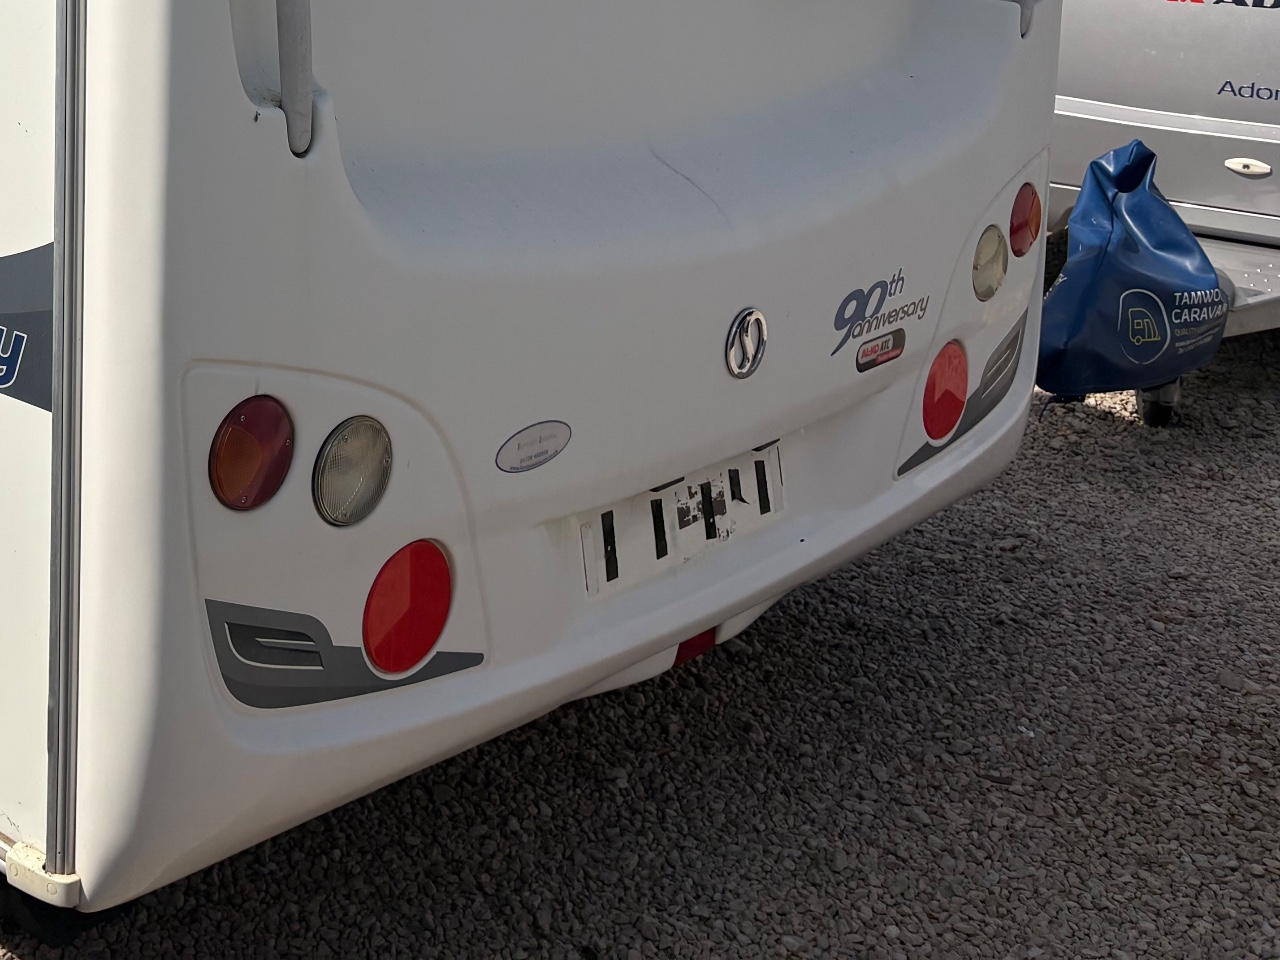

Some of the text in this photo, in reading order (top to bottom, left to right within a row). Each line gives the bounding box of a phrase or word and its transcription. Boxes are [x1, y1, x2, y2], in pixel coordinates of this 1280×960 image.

[830, 268, 905, 357] 90th
[851, 295, 930, 339] anniversary
[1173, 288, 1224, 306] TAMWO
